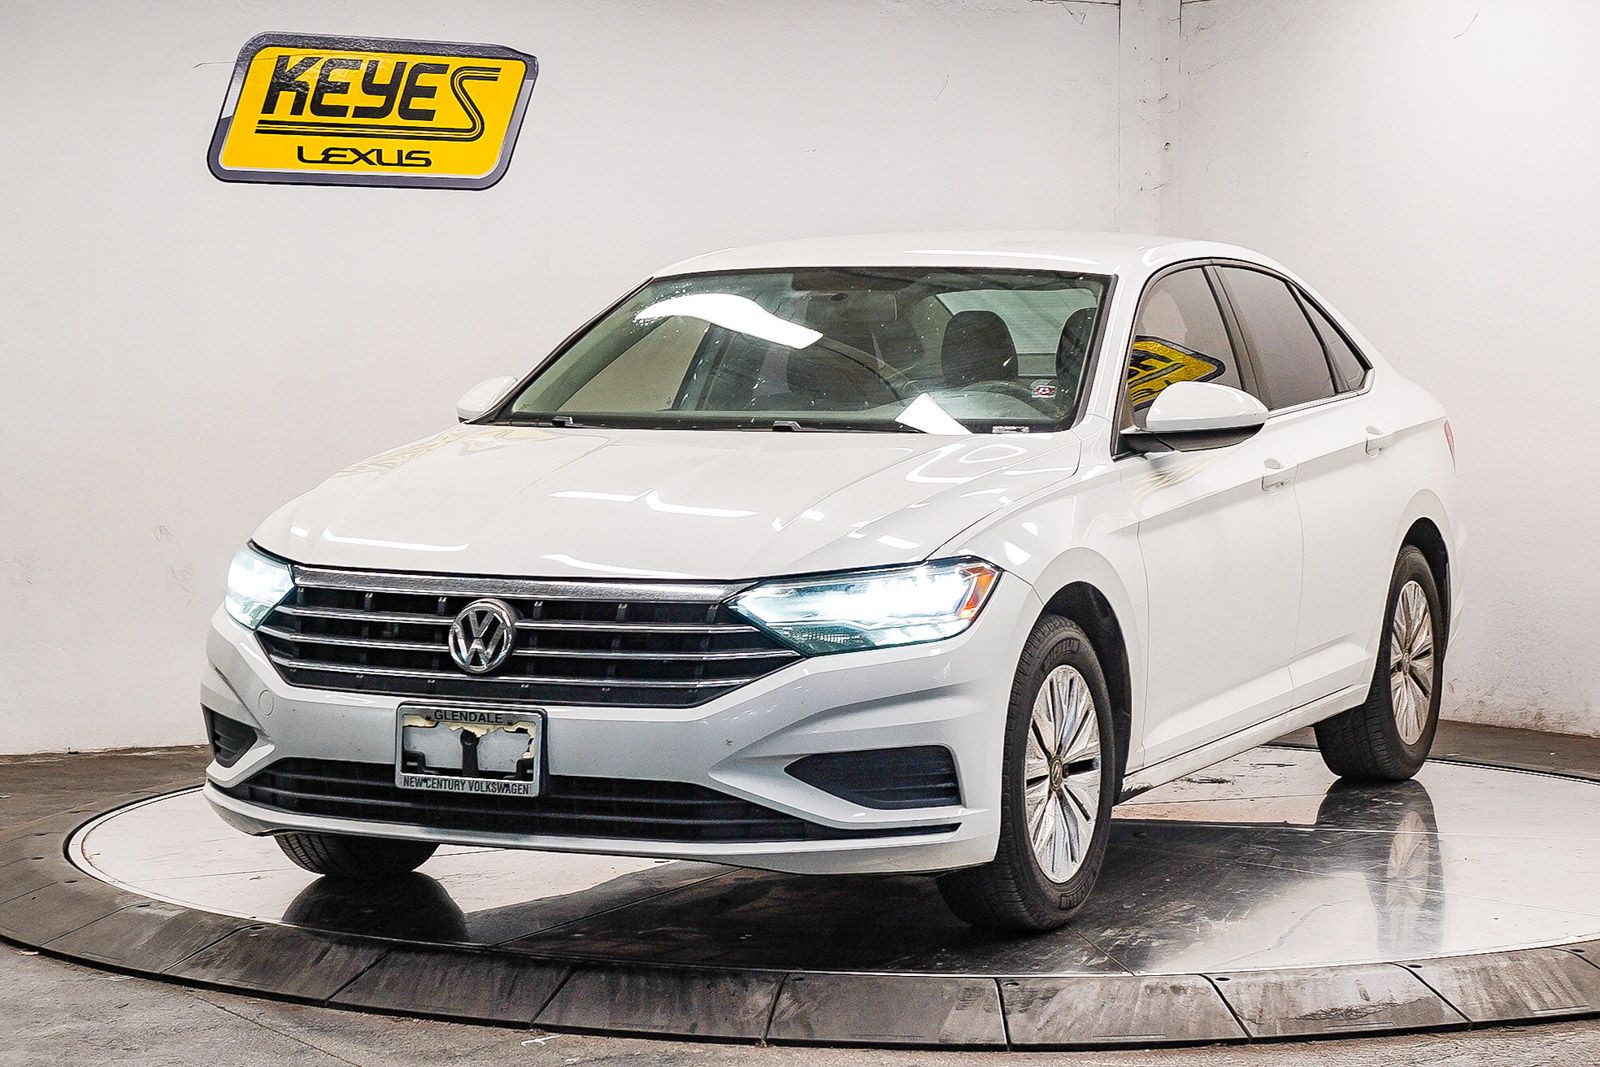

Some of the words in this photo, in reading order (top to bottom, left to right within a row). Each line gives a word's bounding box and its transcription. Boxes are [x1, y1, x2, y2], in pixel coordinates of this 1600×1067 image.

[259, 55, 502, 141] KEYES
[297, 145, 432, 168] LEXUS
[434, 709, 504, 724] GLENDALE
[403, 775, 422, 788] NEW
[426, 777, 465, 791] CENTURY
[469, 780, 529, 795] VOLKSWAGEN
